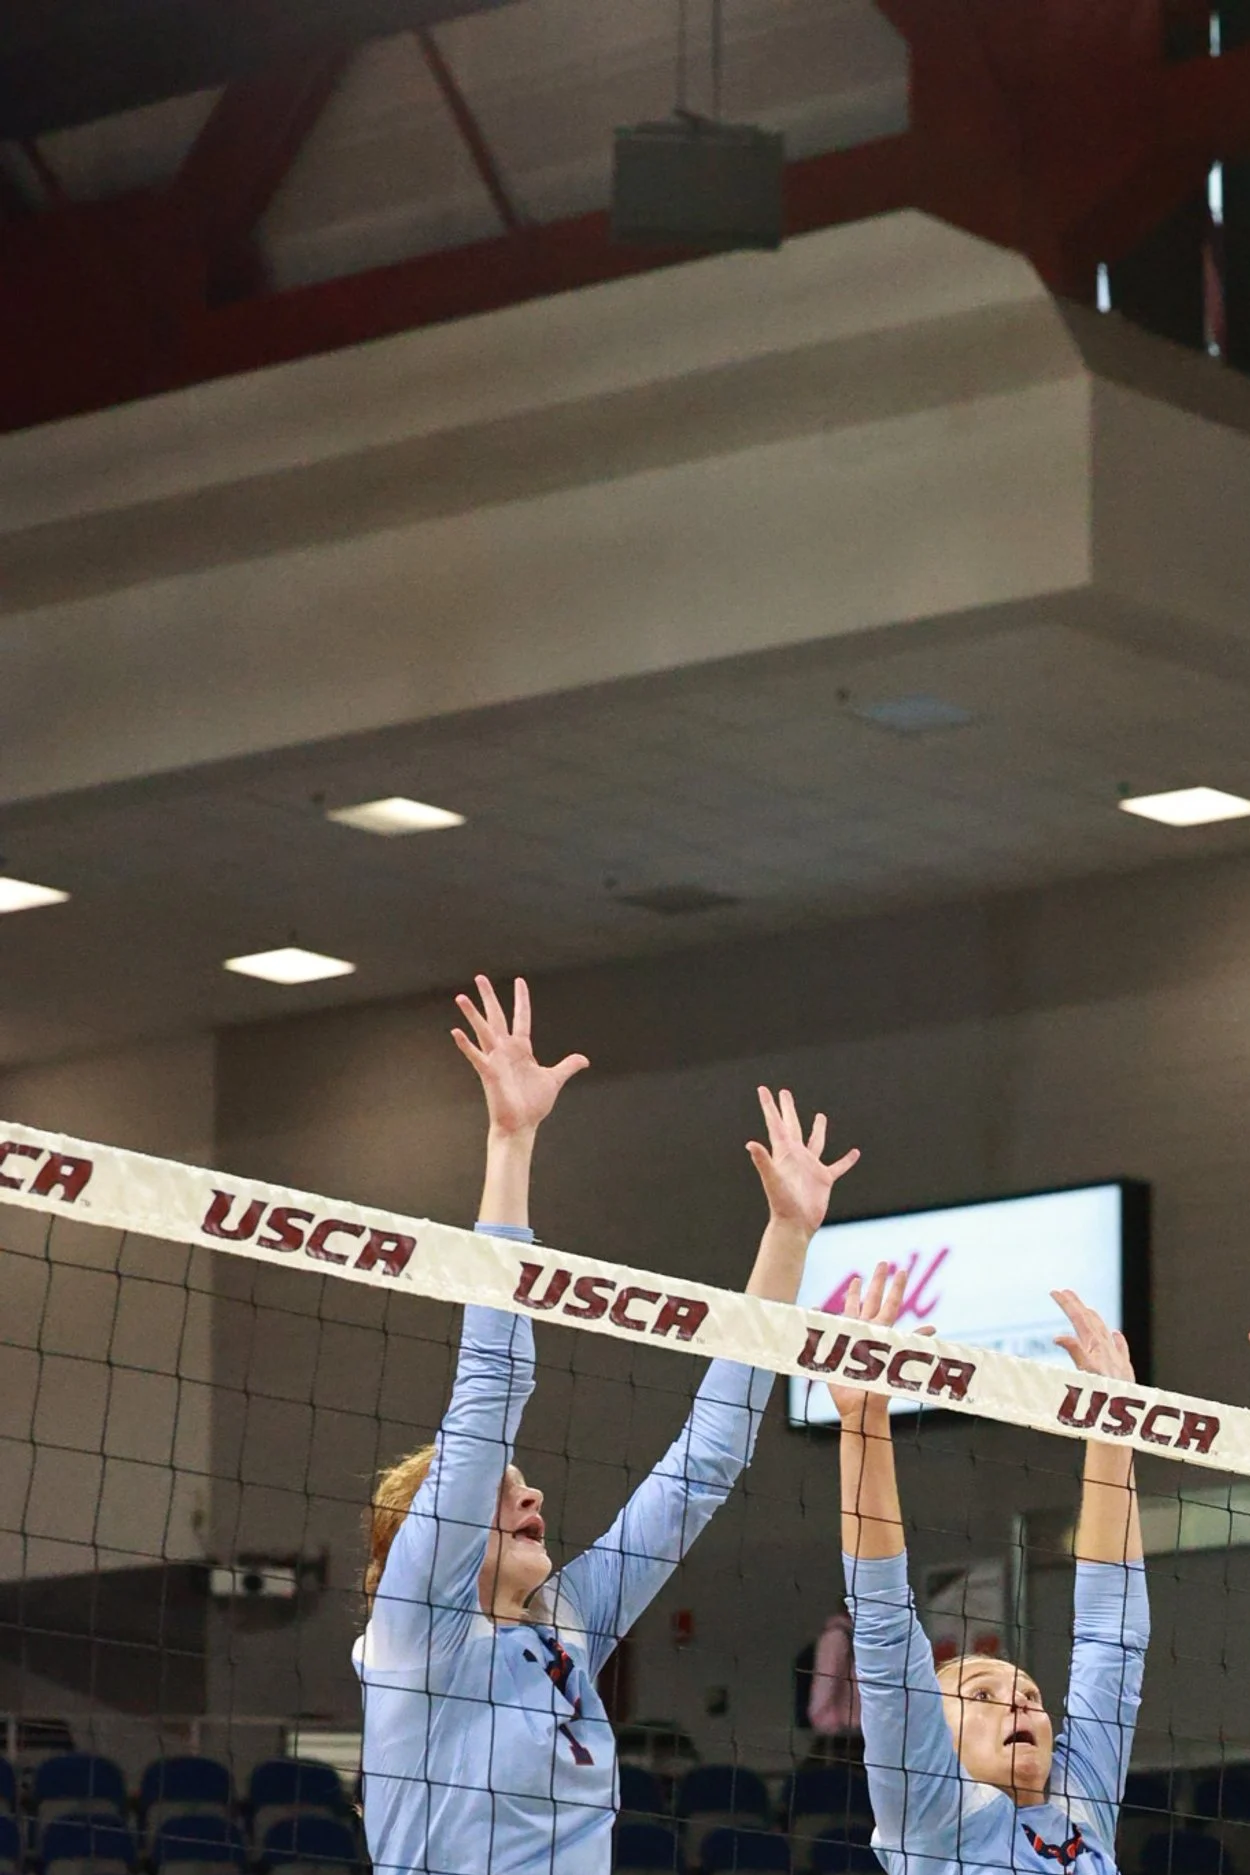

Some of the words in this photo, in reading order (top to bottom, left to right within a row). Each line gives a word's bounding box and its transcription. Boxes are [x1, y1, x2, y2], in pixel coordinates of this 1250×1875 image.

[0, 1140, 94, 1204] CA
[202, 1190, 418, 1280] USCA
[512, 1261, 710, 1343] USCA
[797, 1327, 977, 1402] USCA
[1057, 1384, 1221, 1455] USCA
